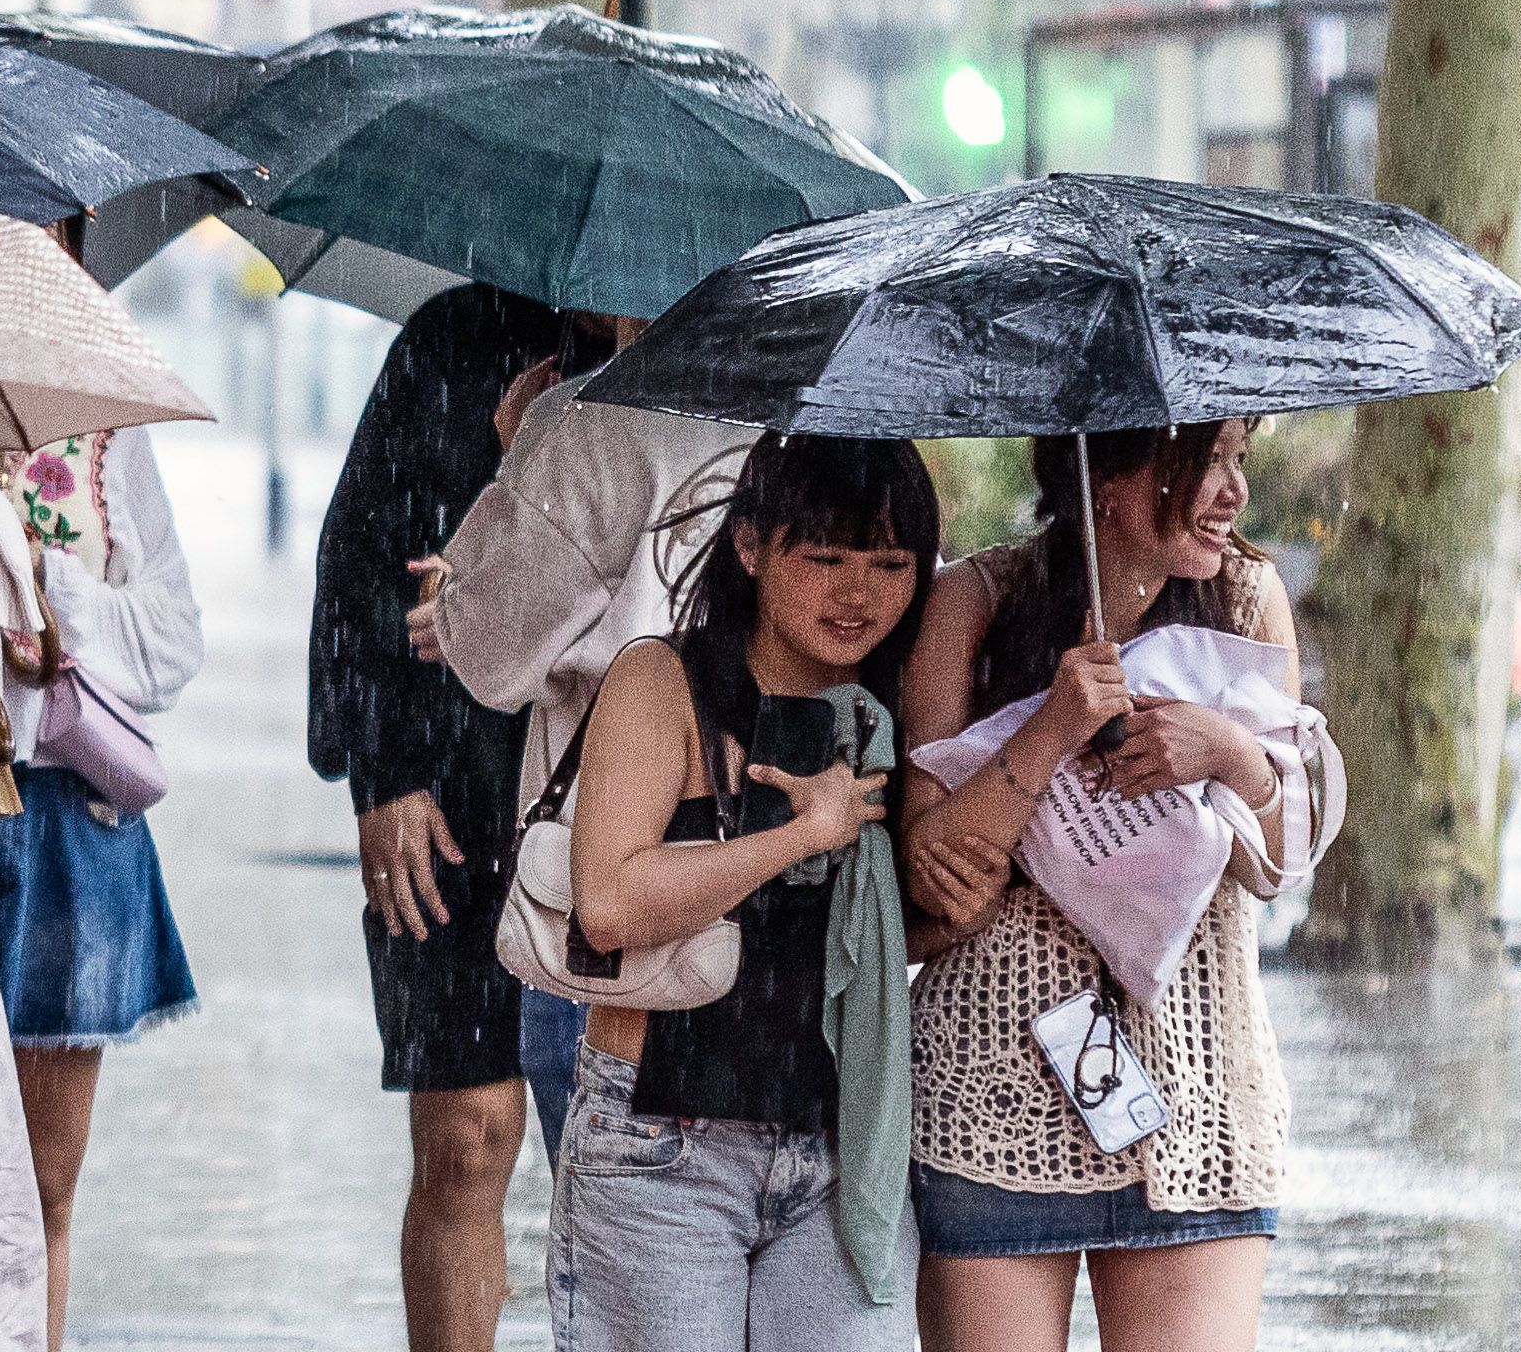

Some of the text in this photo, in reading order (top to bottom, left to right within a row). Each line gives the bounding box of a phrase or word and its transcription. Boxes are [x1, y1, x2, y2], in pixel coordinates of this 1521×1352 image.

[1048, 793, 1098, 867] eow meow
[1055, 771, 1112, 858] meow meow
[1094, 806, 1127, 847] meow
[1132, 799, 1156, 827] eow
